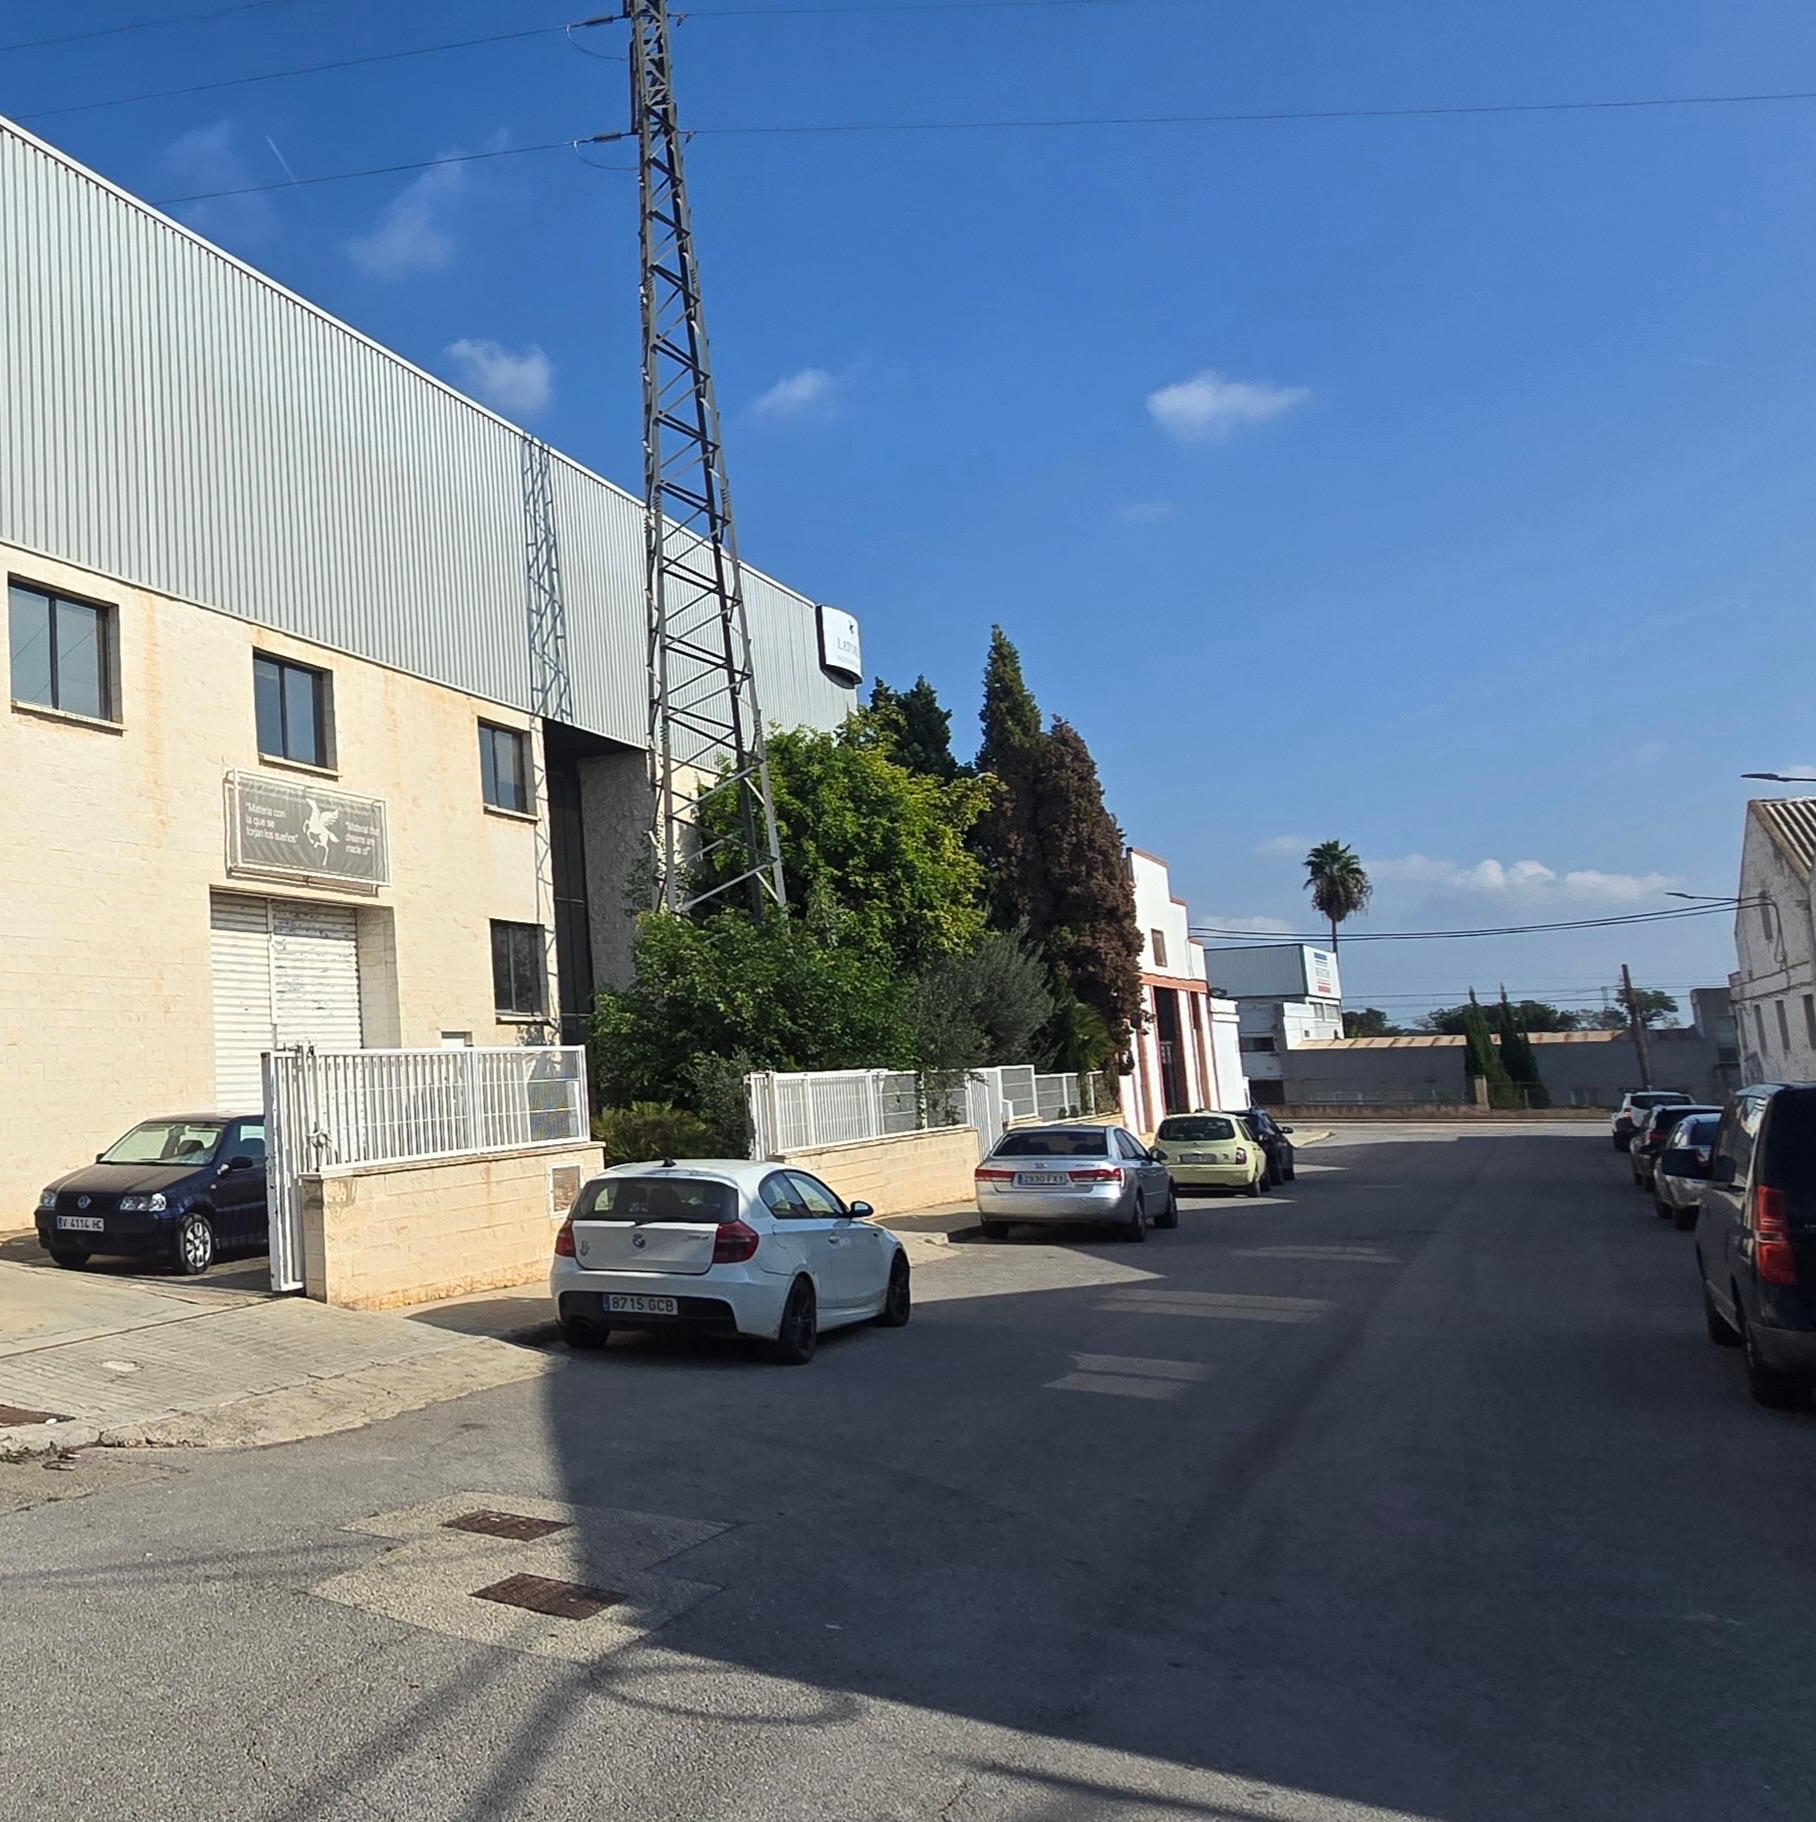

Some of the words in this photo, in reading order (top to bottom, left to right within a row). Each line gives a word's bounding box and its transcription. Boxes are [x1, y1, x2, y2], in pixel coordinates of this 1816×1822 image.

[253, 817, 265, 827] que
[611, 1296, 644, 1311] 8715
[648, 1298, 674, 1313] GCB
